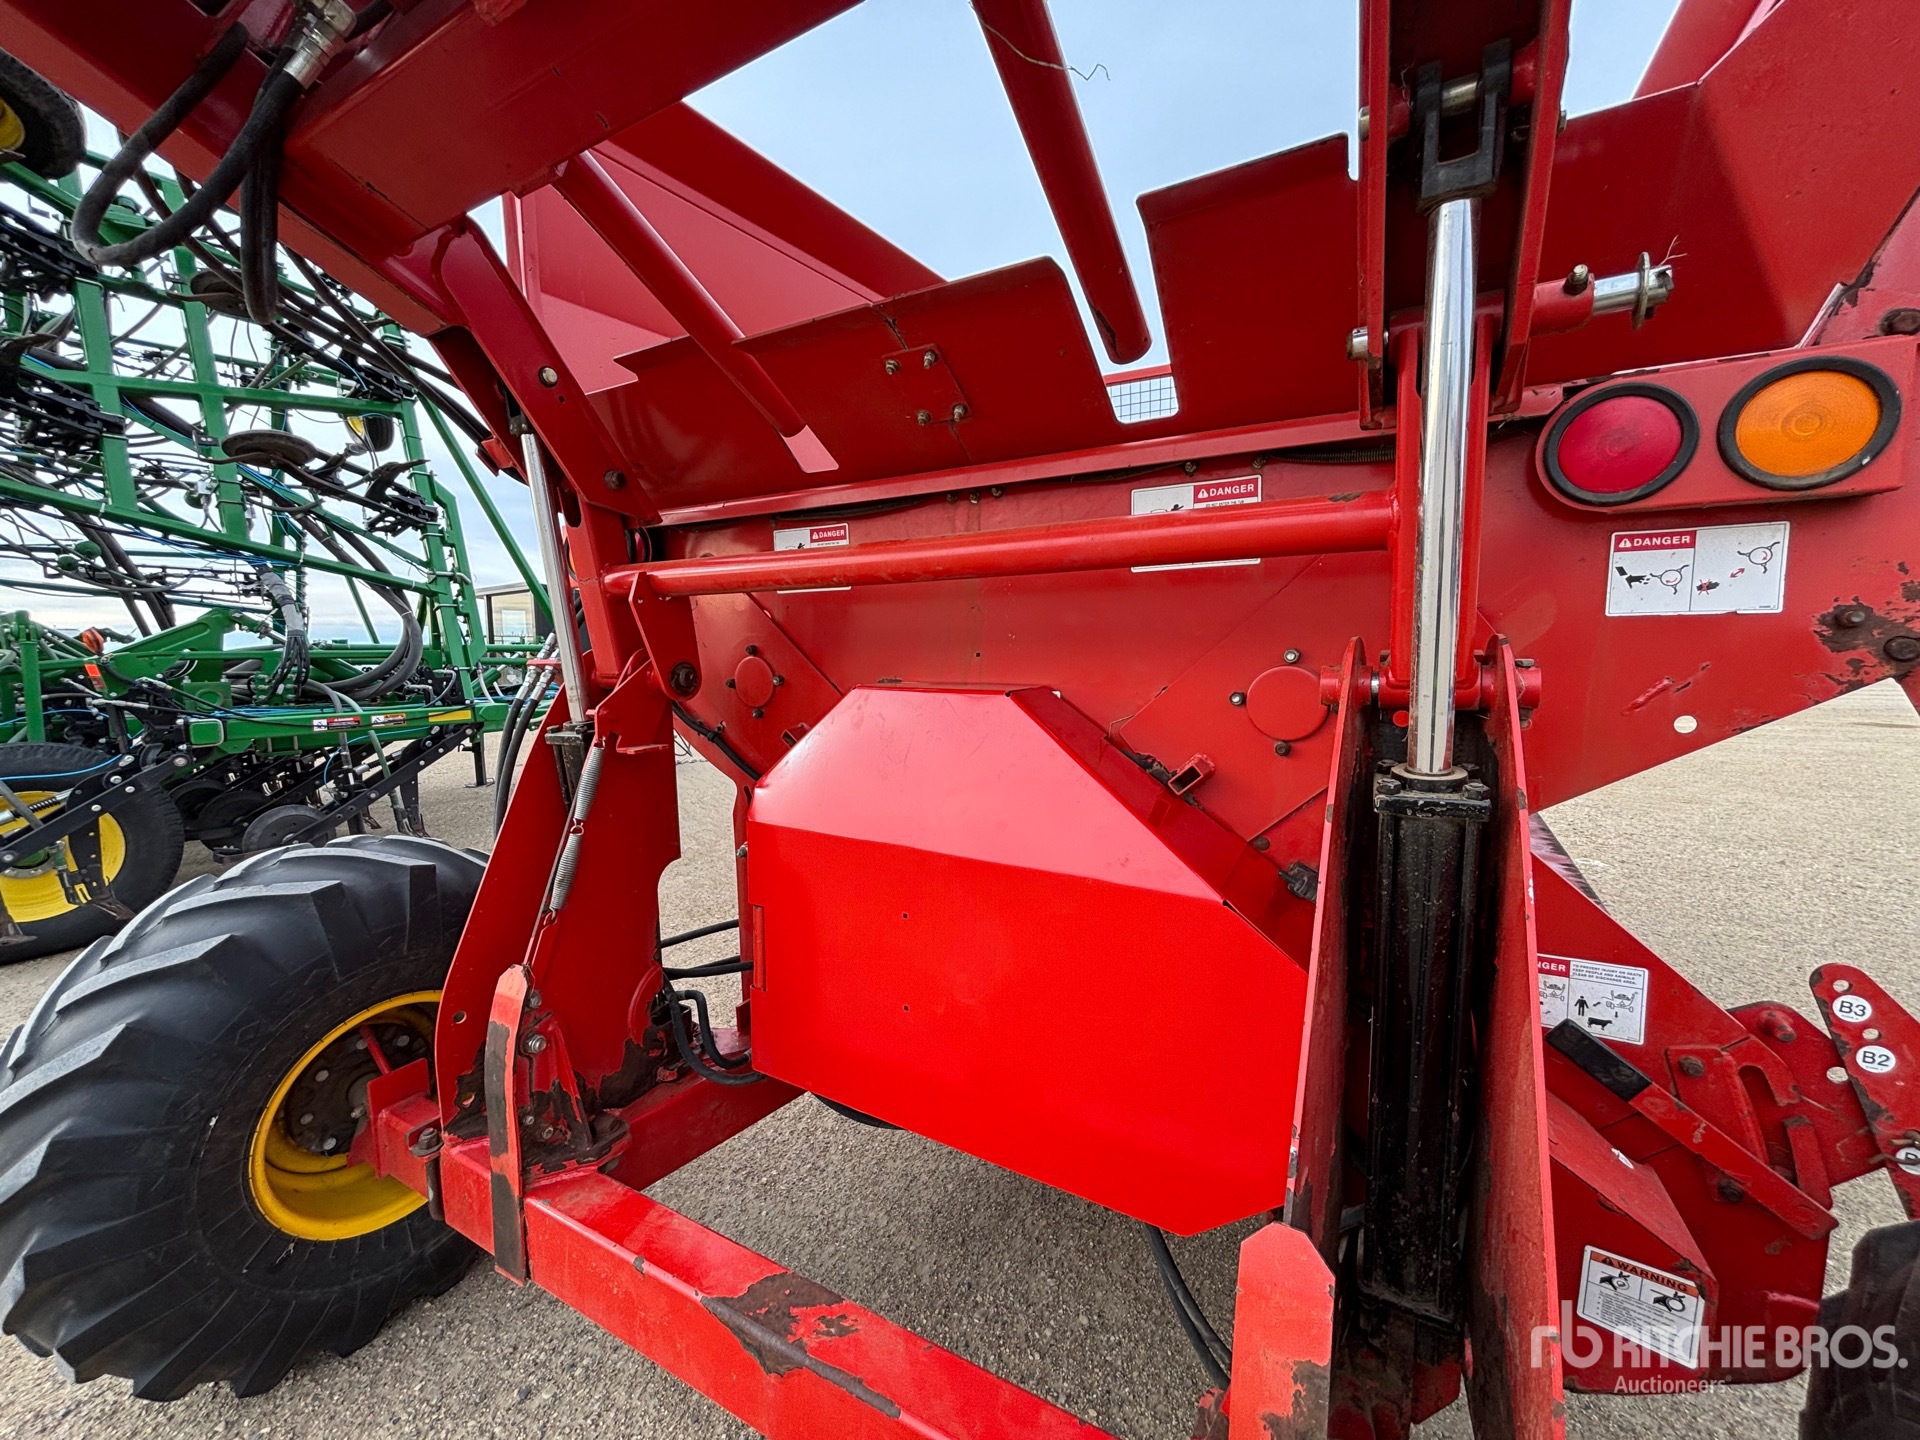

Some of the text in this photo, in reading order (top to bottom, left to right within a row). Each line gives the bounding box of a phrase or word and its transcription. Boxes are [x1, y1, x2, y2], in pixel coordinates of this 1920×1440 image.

[1210, 483, 1254, 497] DANGER
[819, 529, 845, 539] DANGER
[1633, 535, 1691, 547] DANGER
[1838, 1000, 1867, 1017] B3
[1862, 1050, 1890, 1067] B2
[1616, 1261, 1688, 1292] WARNING
